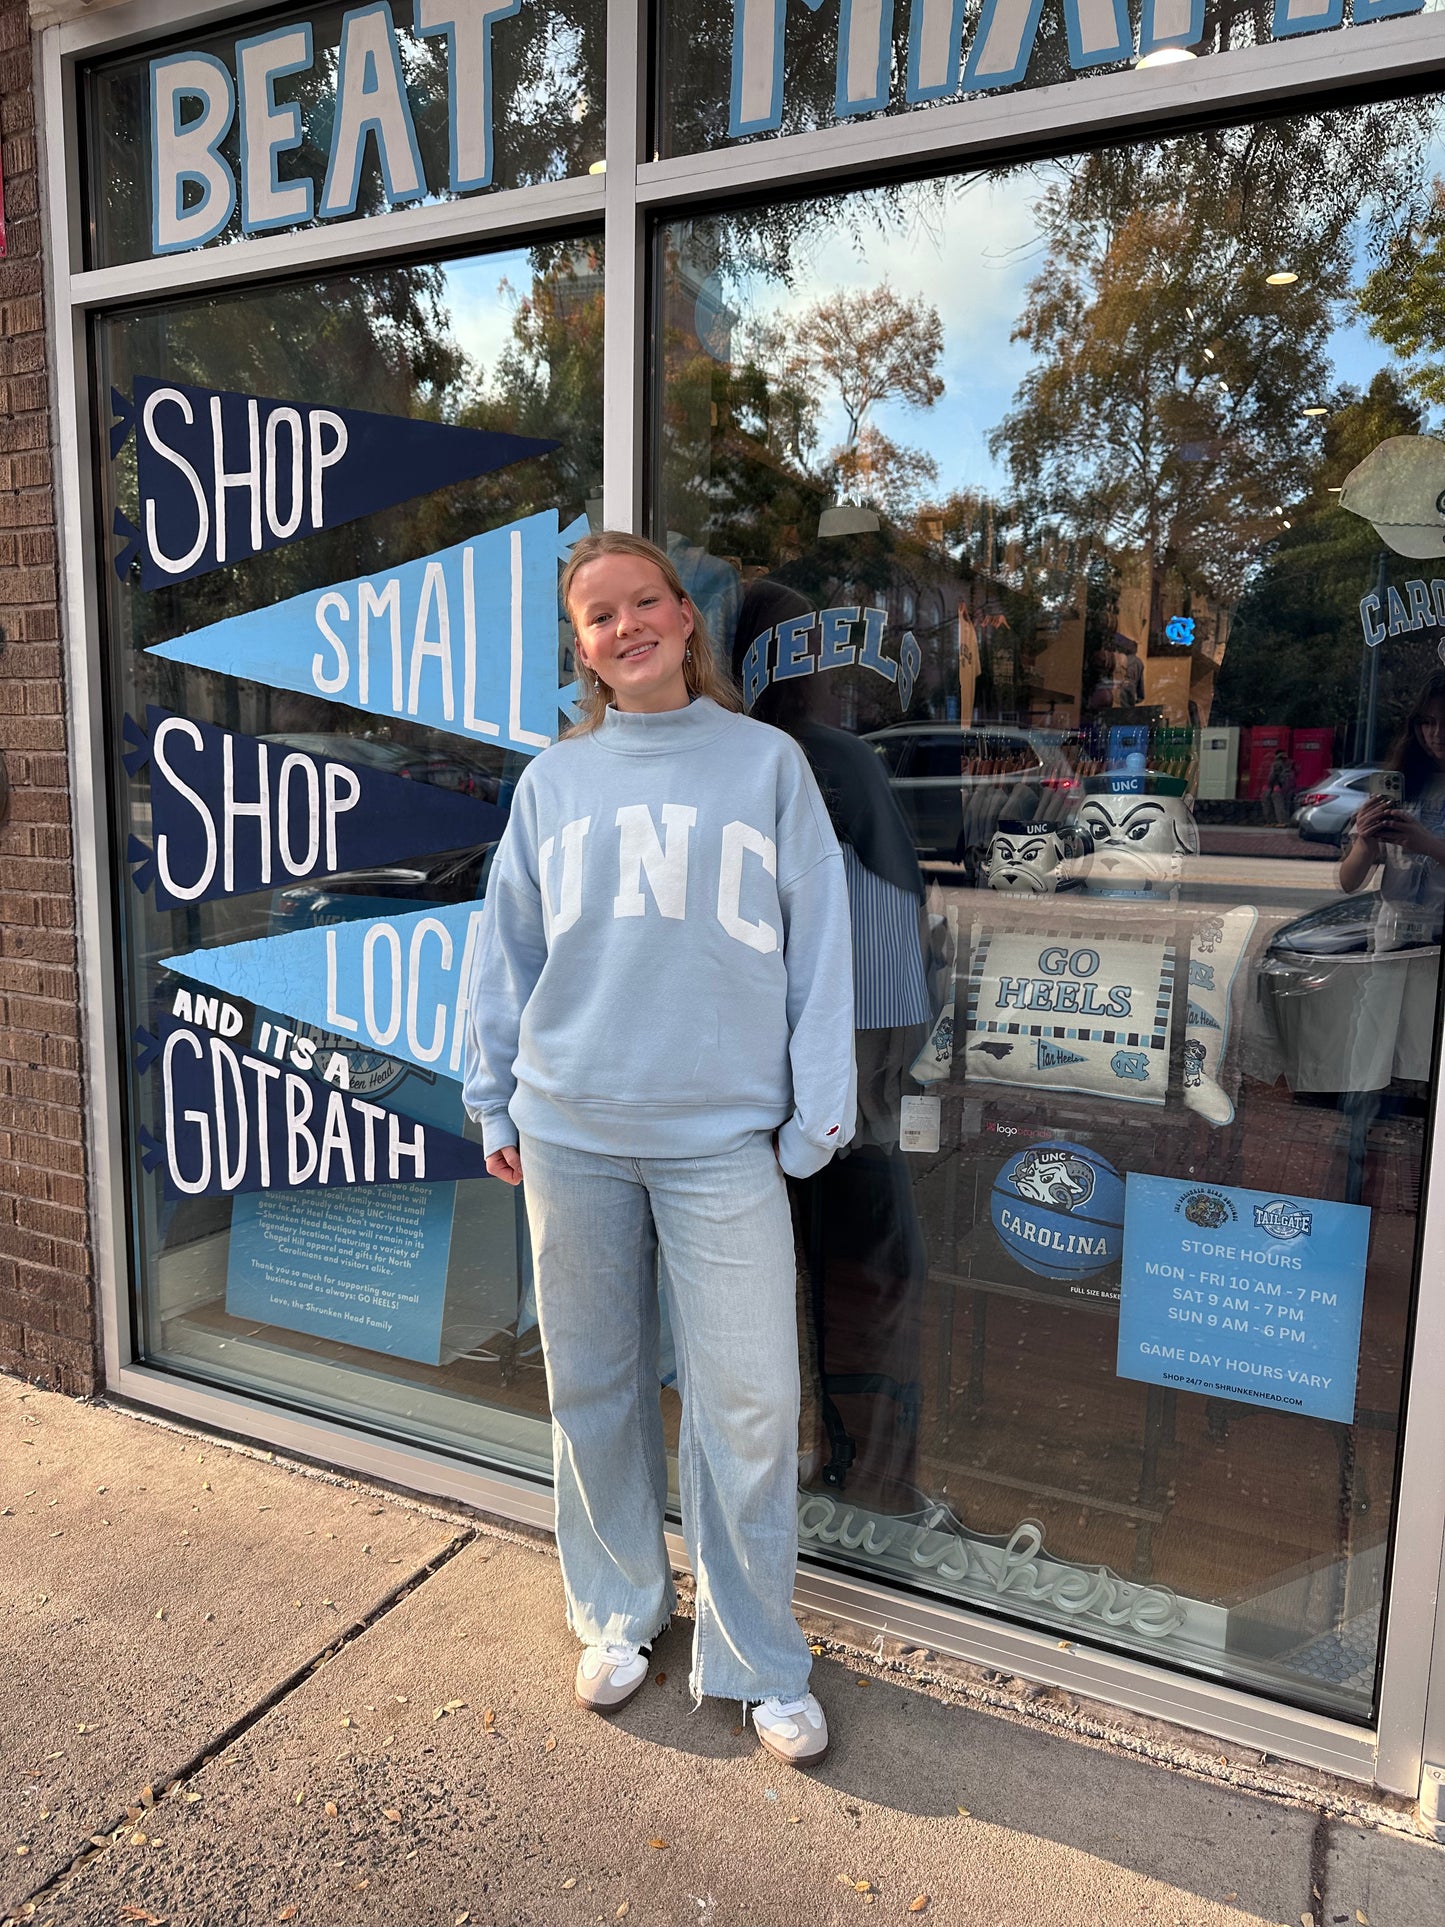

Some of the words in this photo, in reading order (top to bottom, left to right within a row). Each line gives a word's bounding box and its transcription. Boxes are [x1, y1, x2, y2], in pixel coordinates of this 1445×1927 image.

[150, 0, 521, 254] BEAT
[142, 388, 349, 574] SHOP
[312, 531, 552, 748] SMALL
[741, 605, 922, 713] HEELS
[1112, 779, 1138, 792] UNC
[154, 717, 360, 900] SHOP
[1026, 823, 1048, 834] UNC
[538, 803, 779, 954] UNC
[1038, 947, 1100, 977] GO
[995, 976, 1132, 1018] HEELS
[172, 988, 244, 1037] AND
[258, 1021, 317, 1070] IT'S
[323, 1051, 350, 1090] A
[1040, 1044, 1056, 1065] Tar
[1057, 1051, 1084, 1064] Heels
[369, 1061, 394, 1087] Head
[163, 1029, 425, 1194] GDTBATH
[1041, 1153, 1066, 1163] UNC
[377, 1188, 409, 1201] Tailgate
[412, 1196, 427, 1204] will
[409, 1184, 432, 1195] doors
[278, 1202, 289, 1211] for
[292, 1204, 304, 1213] Tar
[306, 1208, 323, 1217] Heel
[346, 1215, 367, 1226] Don't
[369, 1222, 393, 1233] worry
[395, 1225, 423, 1238] though
[301, 1198, 331, 1210] proudly
[333, 1203, 364, 1217] offering
[404, 1207, 425, 1215] small
[1255, 1208, 1311, 1233] TAILGATE
[259, 1219, 297, 1235] legendary
[334, 1234, 370, 1250] featuring
[380, 1246, 408, 1258] variety
[410, 1250, 419, 1258] of
[263, 1231, 290, 1242] Chapel
[291, 1236, 304, 1245] Hill
[306, 1241, 336, 1252] apparel
[338, 1248, 353, 1256] and
[355, 1250, 372, 1260] gifts
[374, 1253, 386, 1262] for
[388, 1256, 411, 1268] North
[301, 1217, 320, 1227] Head
[322, 1221, 356, 1235] Boutique
[358, 1230, 373, 1238] will
[375, 1234, 403, 1244] remain
[405, 1237, 413, 1246] in
[414, 1240, 424, 1249] its
[1001, 1209, 1109, 1256] CAROLINA
[278, 1244, 321, 1260] Carolinians
[340, 1258, 369, 1270] visitors
[1181, 1239, 1236, 1260] STORE
[1240, 1249, 1302, 1270] HOURS
[251, 1259, 273, 1270] Thank
[301, 1272, 321, 1281] much
[323, 1274, 335, 1284] for
[337, 1280, 379, 1296] supporting
[397, 1294, 419, 1303] small
[265, 1272, 296, 1286] business
[298, 1282, 313, 1290] and
[357, 1293, 370, 1303] GO
[1070, 1286, 1085, 1294] FULL
[1086, 1289, 1100, 1297] SIZE
[1100, 1291, 1121, 1300] BASKE
[1145, 1262, 1184, 1280] MON
[1200, 1271, 1225, 1287] FRI
[1229, 1276, 1250, 1291] 10
[1254, 1281, 1281, 1296] AM
[1296, 1288, 1306, 1300] 7
[1310, 1290, 1338, 1307] PM
[292, 1299, 304, 1309] the
[306, 1303, 342, 1318] Shrunken
[344, 1312, 364, 1323] Head
[366, 1317, 392, 1332] Family
[1172, 1288, 1204, 1303] SAT
[1208, 1293, 1218, 1306] 9
[1222, 1297, 1249, 1312] AM
[1264, 1303, 1273, 1315] 7
[1277, 1306, 1304, 1322] PM
[1168, 1307, 1202, 1324] SUN
[1207, 1314, 1218, 1327] 9
[1221, 1318, 1249, 1332] AM
[1264, 1325, 1275, 1337] 6
[1279, 1327, 1306, 1343] PM
[1139, 1342, 1185, 1361] GAME
[1189, 1351, 1222, 1367] DAY
[1226, 1358, 1283, 1380] HOURS
[1286, 1369, 1333, 1389] VARY
[1163, 1372, 1185, 1382] SHOP
[1185, 1376, 1203, 1386] 24/7
[1215, 1383, 1303, 1406] SHRUNKENHEAD.COM
[910, 1508, 968, 1581] is
[997, 1523, 1185, 1638] here
